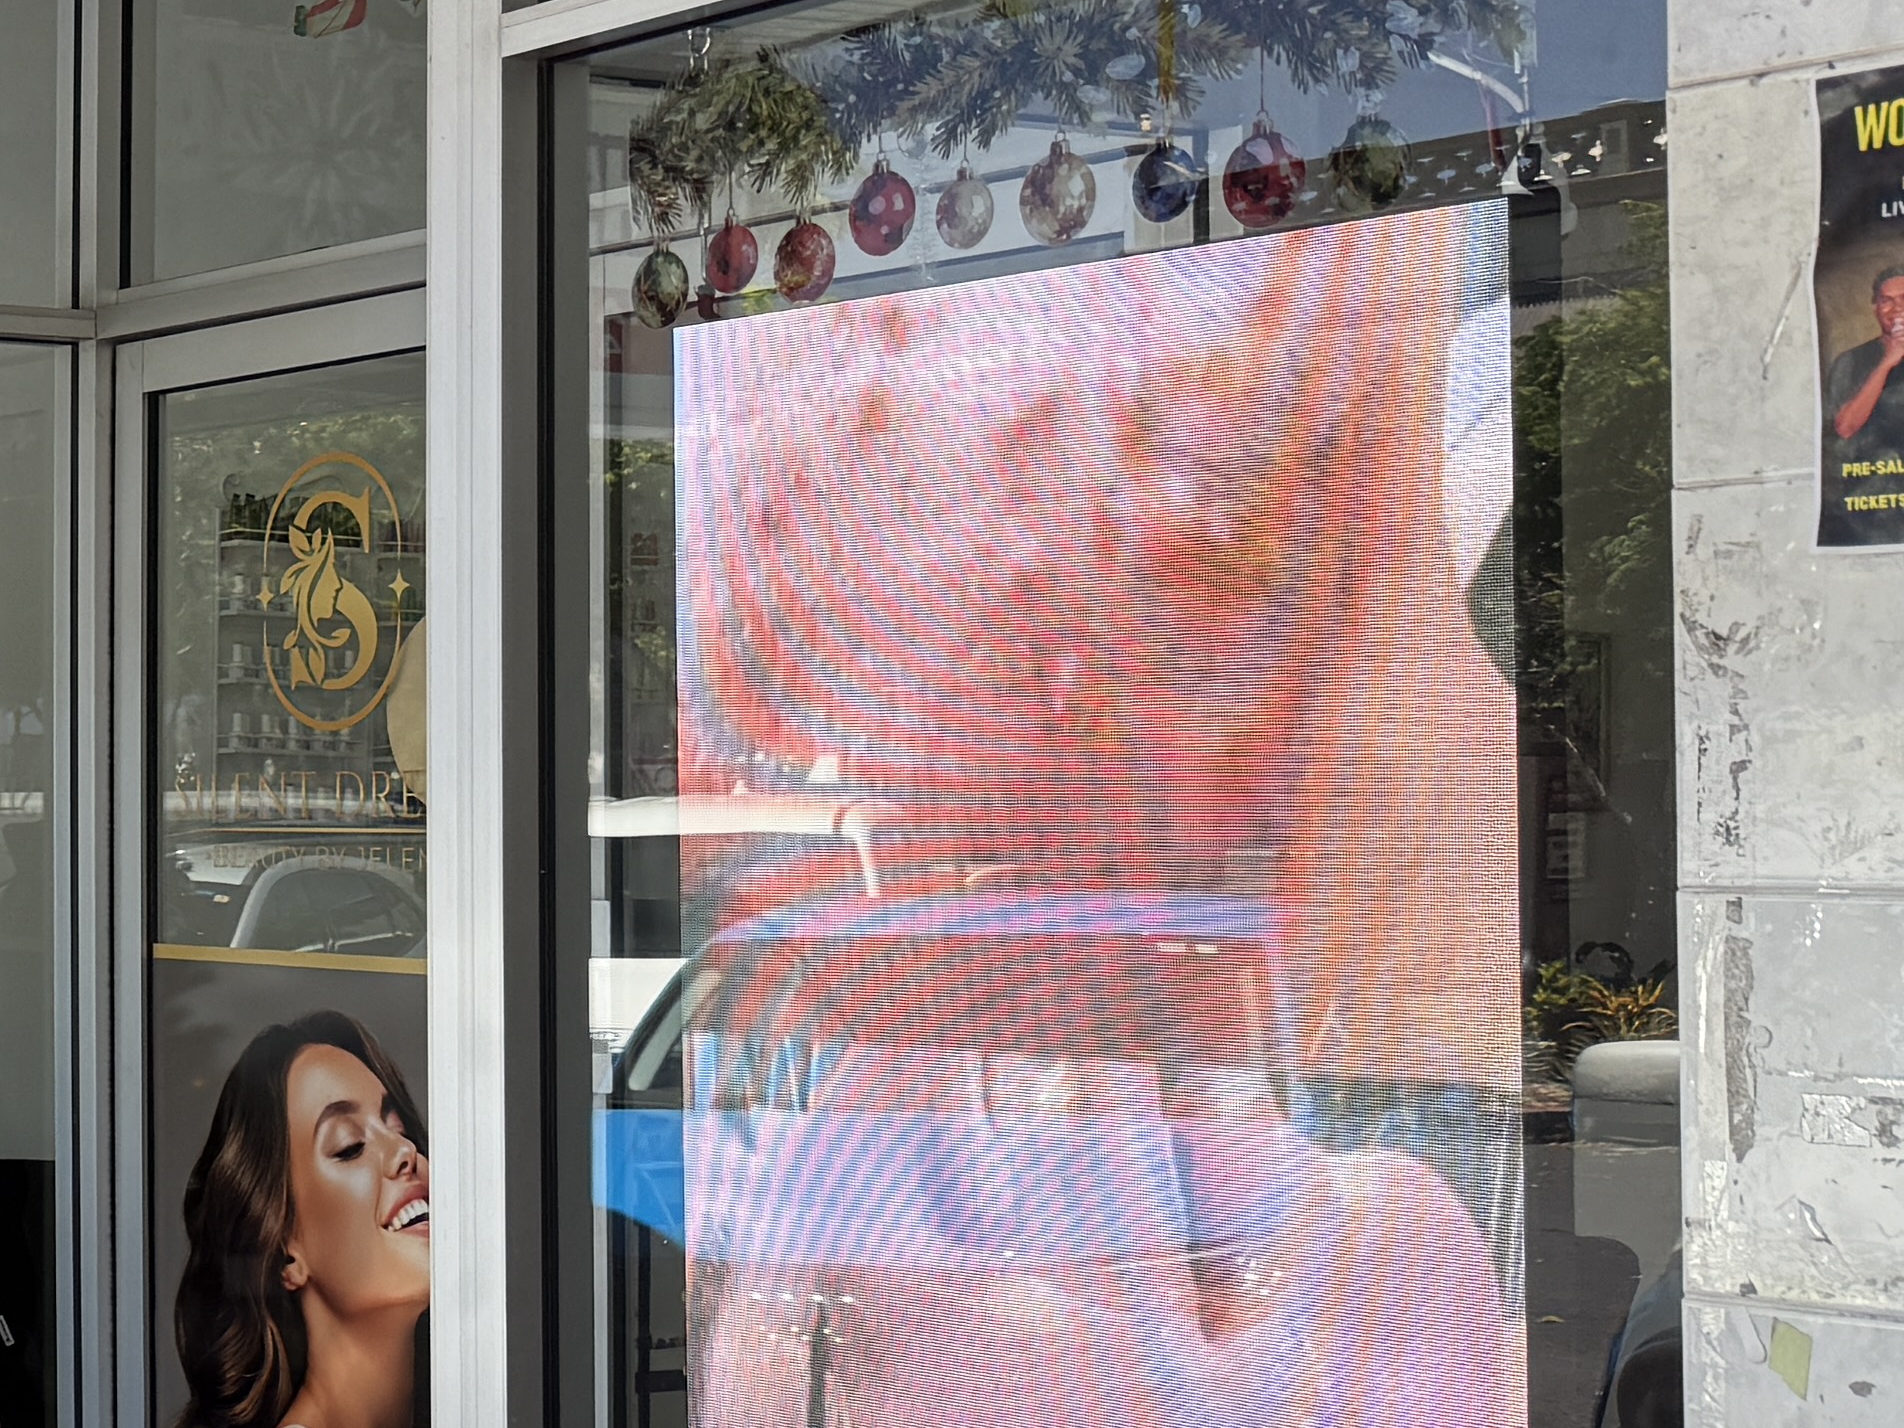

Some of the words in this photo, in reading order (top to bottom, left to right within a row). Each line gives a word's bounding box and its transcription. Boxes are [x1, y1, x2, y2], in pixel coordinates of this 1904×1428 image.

[175, 771, 316, 822] SILENT
[335, 771, 423, 818] DRE
[357, 845, 427, 872] JELEN
